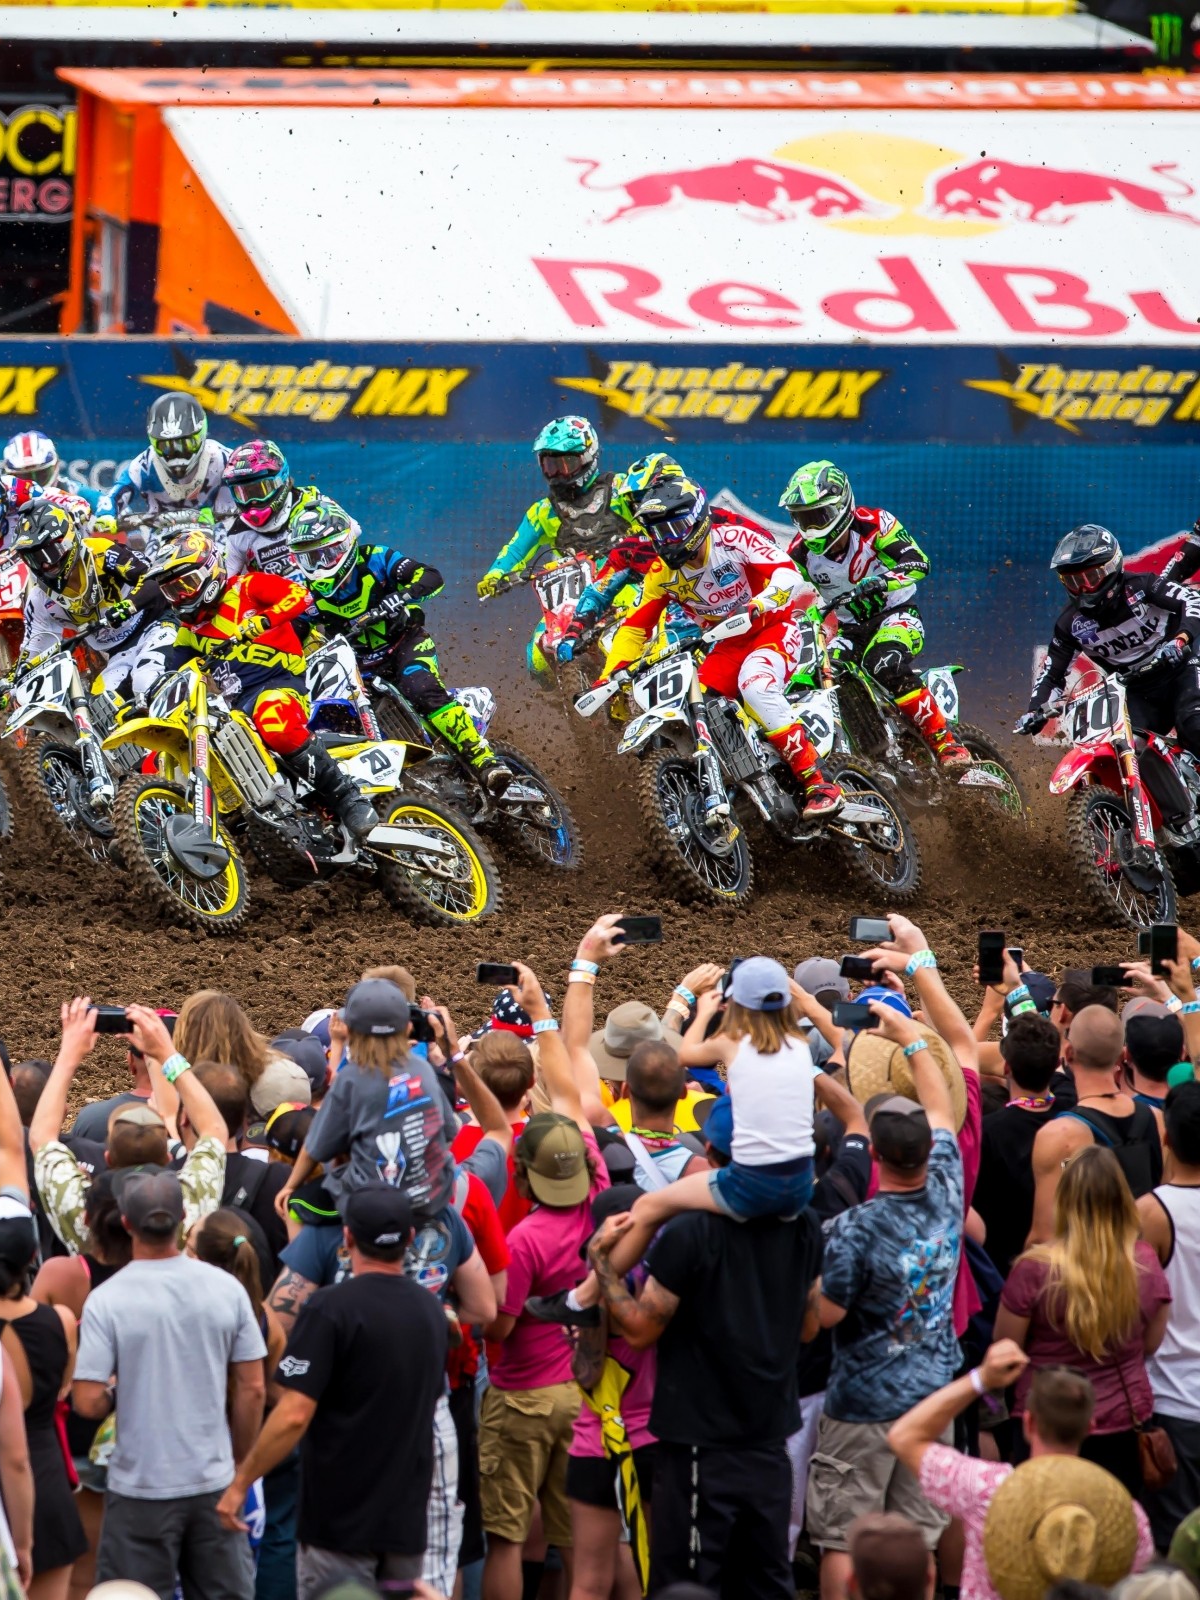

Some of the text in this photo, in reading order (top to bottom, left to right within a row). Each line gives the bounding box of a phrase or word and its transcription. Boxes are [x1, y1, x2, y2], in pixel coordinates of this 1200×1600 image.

[531, 256, 958, 332] Red
[190, 359, 376, 389] Thunder
[213, 367, 470, 422] Valley MX
[602, 361, 788, 392] Thunder
[1012, 363, 1197, 394] Thunder
[628, 370, 882, 424] Valley MX
[1038, 390, 1173, 427] Valley
[260, 544, 290, 560] Autotra
[343, 597, 363, 612] thor
[1096, 616, 1160, 658] O'NEAL
[25, 663, 62, 704] 21
[642, 664, 684, 710] 15
[1072, 692, 1121, 742] 40
[195, 734, 207, 768] SHOWA
[359, 747, 391, 777] 20
[195, 779, 204, 824] DUNLOP
[1132, 795, 1147, 838] DUNLOP
